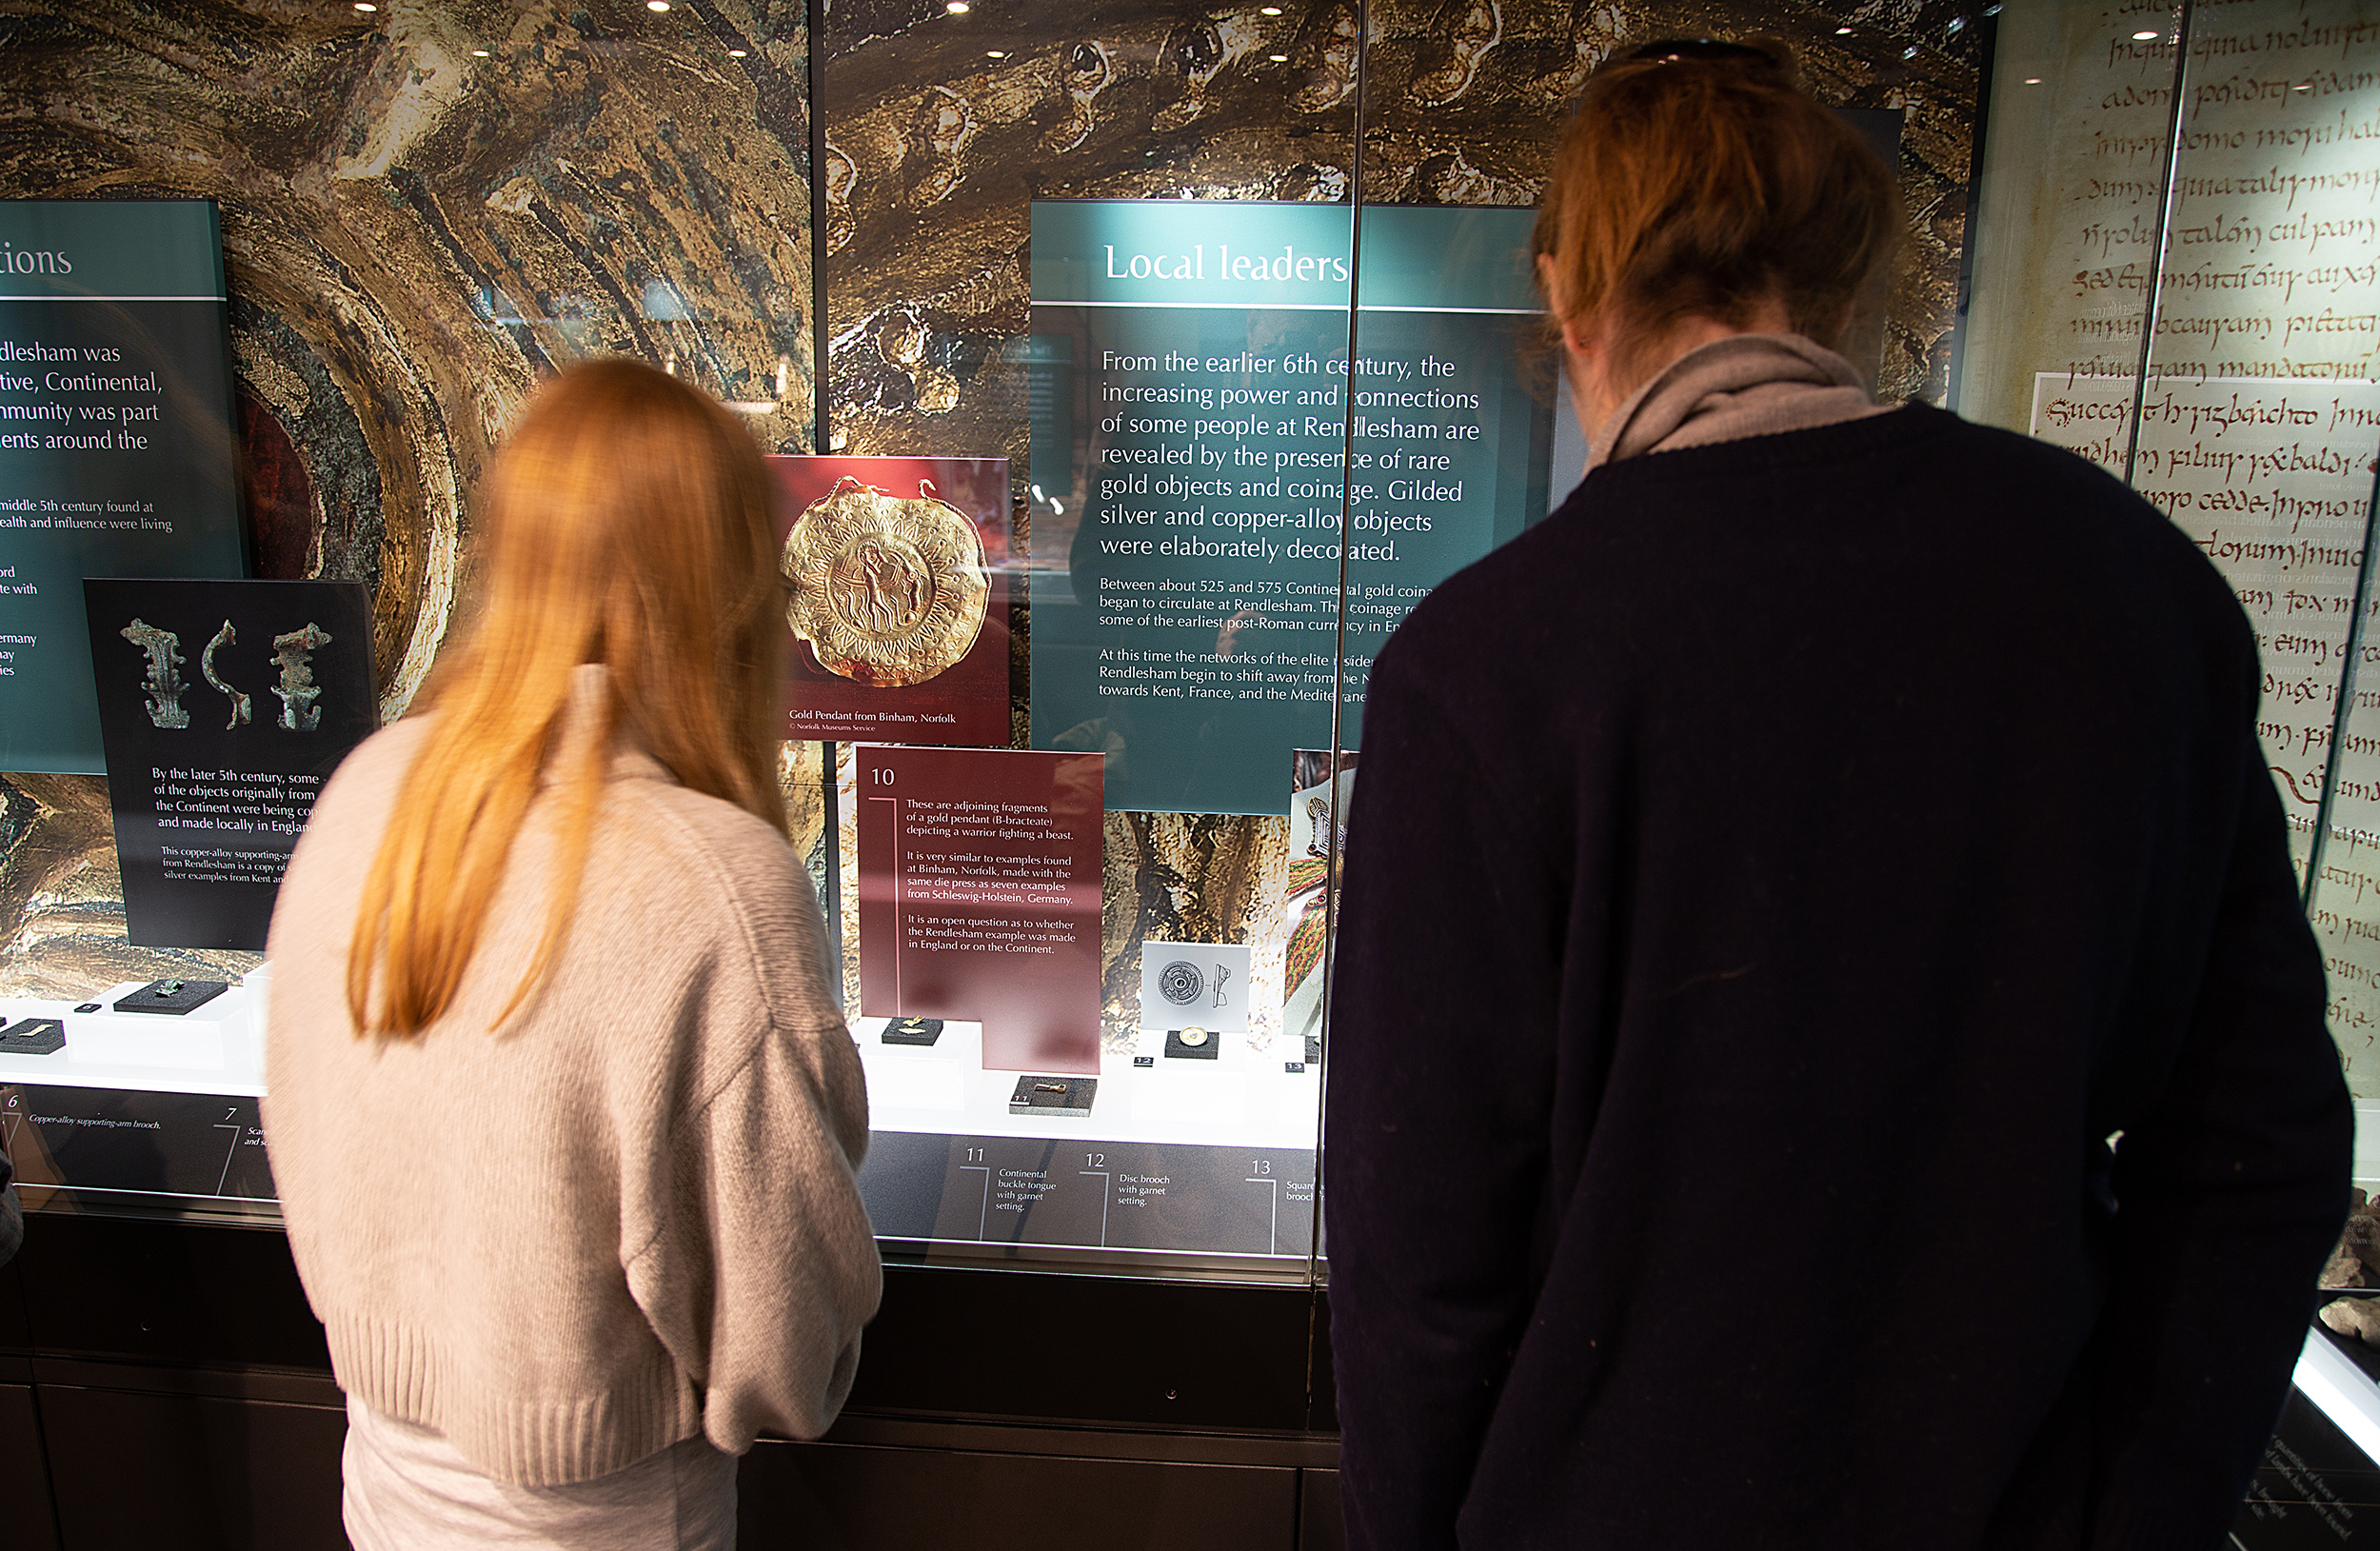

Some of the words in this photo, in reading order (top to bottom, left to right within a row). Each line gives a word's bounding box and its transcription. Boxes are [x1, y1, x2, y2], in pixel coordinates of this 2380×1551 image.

[1104, 245, 1205, 280] Local
[1220, 245, 1350, 283] leaders
[83, 348, 121, 362] was
[1103, 351, 1157, 371] From
[1164, 350, 1199, 372] the
[1206, 351, 1277, 373] earlier
[1284, 353, 1318, 374] 6th
[1420, 355, 1456, 377] the
[46, 371, 162, 395] Continental,
[1103, 382, 1214, 410] increasing
[1221, 389, 1290, 410] power
[1298, 386, 1339, 406] and
[78, 407, 116, 421] was
[123, 405, 160, 427] part
[1101, 412, 1123, 434] of
[1128, 418, 1188, 435] some
[1195, 415, 1270, 442] people
[1276, 418, 1297, 436] at
[1445, 425, 1480, 441] are
[0, 432, 40, 449] ents
[46, 430, 112, 449] around
[118, 430, 148, 450] the
[1102, 445, 1193, 465] revealed
[1201, 446, 1227, 471] by
[1234, 447, 1268, 467] the
[1379, 448, 1402, 469] of
[1408, 455, 1450, 470] rare
[1101, 474, 1148, 501] gold
[1156, 475, 1233, 502] objects
[1240, 477, 1280, 497] and
[1288, 478, 1379, 505] coinage.
[1389, 480, 1462, 502] Gilded
[0, 498, 37, 511] middle
[40, 499, 59, 511] 5th
[61, 502, 104, 516] century
[107, 500, 140, 513] found
[143, 503, 154, 513] at
[30, 516, 51, 528] and
[54, 516, 107, 529] influence
[109, 520, 138, 529] were
[140, 517, 173, 533] living
[1101, 505, 1158, 525] silver
[1165, 507, 1204, 527] and
[1354, 509, 1432, 536] objects
[1100, 540, 1153, 555] were
[1160, 537, 1279, 565] elaborately
[1287, 538, 1400, 566] decoated.
[11, 582, 38, 595] with
[1100, 577, 1155, 591] Between
[1158, 578, 1197, 593] about
[1199, 579, 1225, 593] 525
[1228, 579, 1254, 593] and
[1257, 580, 1282, 594] 575
[1285, 580, 1361, 597] Continetal
[1364, 583, 1395, 601] gold
[1098, 683, 1150, 697] towards
[1152, 684, 1185, 700] Kent,
[1188, 685, 1235, 701] France,
[1238, 686, 1263, 700] and
[1266, 686, 1287, 701] the
[789, 709, 813, 720] Gold
[815, 710, 852, 721] Pendant
[854, 710, 877, 721] from
[879, 711, 918, 724] Binham,
[921, 713, 957, 724] Norfolk
[151, 767, 168, 782] By
[169, 766, 188, 780] the
[190, 767, 216, 781] later
[219, 768, 238, 782] 5th
[240, 772, 286, 786] century,
[288, 774, 320, 785] some
[871, 768, 895, 785] 10
[153, 783, 166, 795] of
[168, 783, 187, 796] the
[188, 784, 229, 800] objects
[231, 786, 286, 803] originally
[288, 787, 315, 801] from
[155, 799, 174, 811] the
[175, 800, 230, 814] Continent
[232, 805, 261, 815] were
[262, 803, 295, 820] being
[905, 798, 934, 809] These
[936, 802, 952, 810] are
[953, 800, 1000, 814] adjoining
[1002, 802, 1048, 815] fragments
[158, 815, 180, 827] and
[182, 816, 214, 829] made
[216, 817, 254, 834] locally
[257, 819, 268, 831] in
[905, 811, 918, 823] of
[918, 814, 925, 823] a
[926, 811, 949, 825] gold
[950, 813, 990, 825] pendant
[991, 814, 1054, 827] (B-bracteate)
[906, 825, 952, 838] depicting
[962, 827, 997, 837] warrior
[999, 827, 1036, 842] fighting
[1045, 829, 1074, 840] beast.
[161, 845, 179, 858] This
[180, 847, 233, 862] copper-alloy
[907, 887, 930, 899] from
[932, 889, 1024, 904] Schleswig-Holstein,
[1027, 893, 1074, 907] Germany.
[8, 1094, 19, 1108] 6
[29, 1114, 76, 1126] Copper-alloy
[76, 1118, 132, 1128] supporting-arm
[132, 1120, 161, 1130] brooch.
[225, 1107, 237, 1121] 7
[244, 1137, 261, 1145] and
[967, 1147, 983, 1162] 11
[1086, 1153, 1104, 1167] 12
[999, 1168, 1047, 1179] Continental
[1252, 1160, 1271, 1175] 13
[998, 1179, 1026, 1190] buckle
[1027, 1182, 1057, 1192] tongue
[1120, 1173, 1139, 1183] Disc
[1140, 1174, 1170, 1184] brooch
[997, 1190, 1016, 1202] with
[1017, 1193, 1043, 1202] garnet
[1118, 1184, 1138, 1196] with
[1139, 1187, 1166, 1197] garnet
[995, 1202, 1025, 1213] setting.
[1118, 1196, 1147, 1208] setting.
